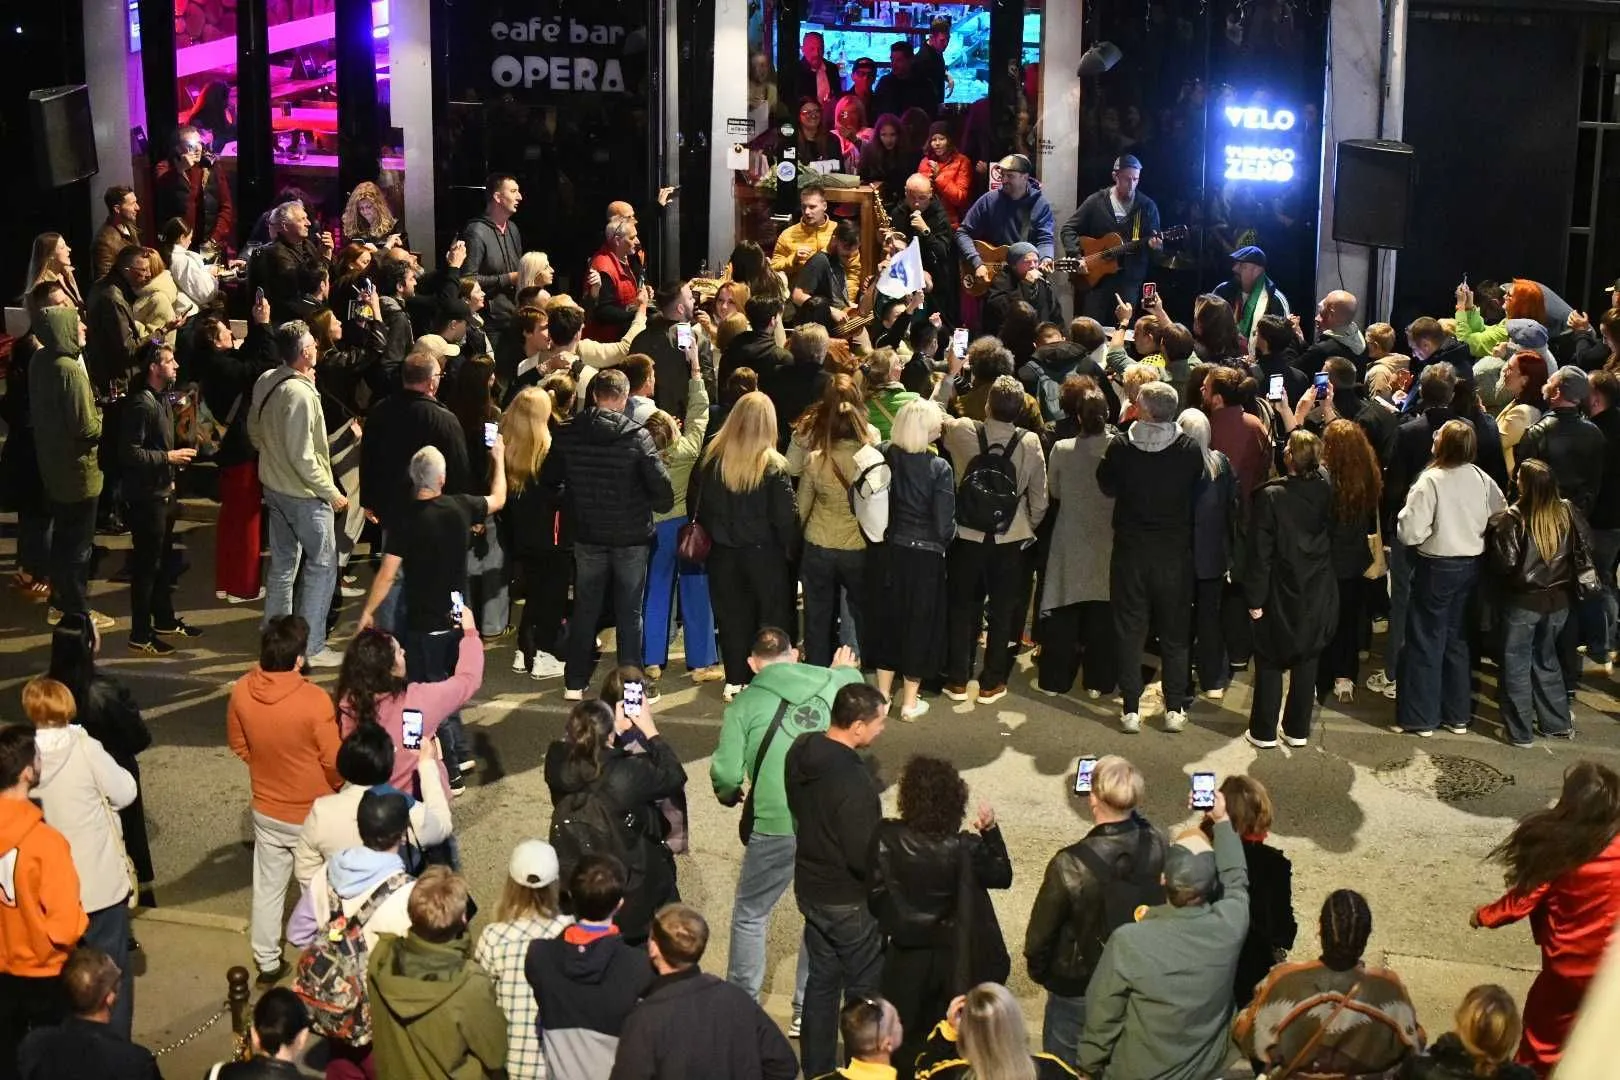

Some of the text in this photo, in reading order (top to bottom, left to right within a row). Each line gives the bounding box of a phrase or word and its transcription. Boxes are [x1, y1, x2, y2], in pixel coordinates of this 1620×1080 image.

[569, 16, 625, 45] bar
[491, 55, 625, 93] OPERA
[1224, 106, 1296, 131] VELO
[1224, 158, 1294, 182] ZERO
